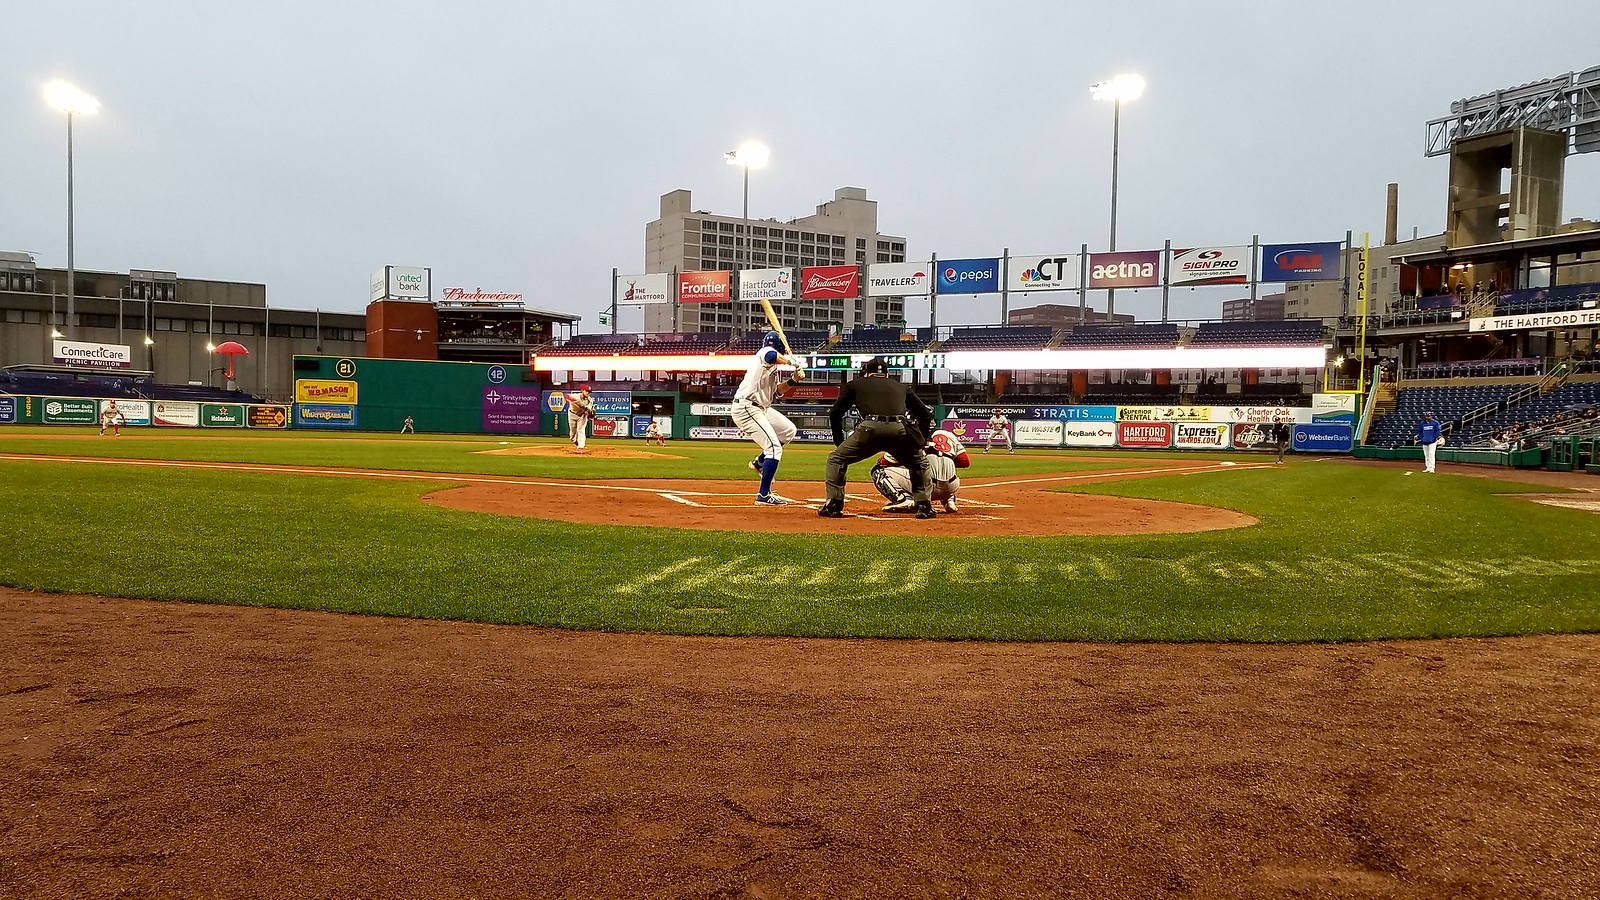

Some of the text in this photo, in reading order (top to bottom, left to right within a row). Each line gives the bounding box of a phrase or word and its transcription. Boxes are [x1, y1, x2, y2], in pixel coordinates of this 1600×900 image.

[1037, 258, 1068, 281] CT
[1092, 260, 1154, 279] aetna
[1183, 260, 1239, 269] SIGN PRO
[396, 274, 422, 282] united
[959, 268, 993, 282] pepsi
[1357, 253, 1365, 300] LOCAL
[399, 282, 420, 291] bank
[681, 282, 727, 294] Frontier
[742, 279, 777, 290] Hartford
[808, 277, 850, 288] Budweiser
[870, 278, 916, 287] TRAVELERS
[442, 288, 521, 301] Budweiser
[742, 289, 787, 299] HealthCare
[1494, 319, 1514, 329] THE
[1517, 314, 1578, 328] HARTFORD
[61, 346, 124, 360] ConnectiCare
[340, 363, 351, 373] 21
[490, 369, 503, 379] 42
[1034, 408, 1089, 418] STRATIS
[1123, 426, 1166, 437] HARTFORD
[1177, 424, 1217, 437] Express
